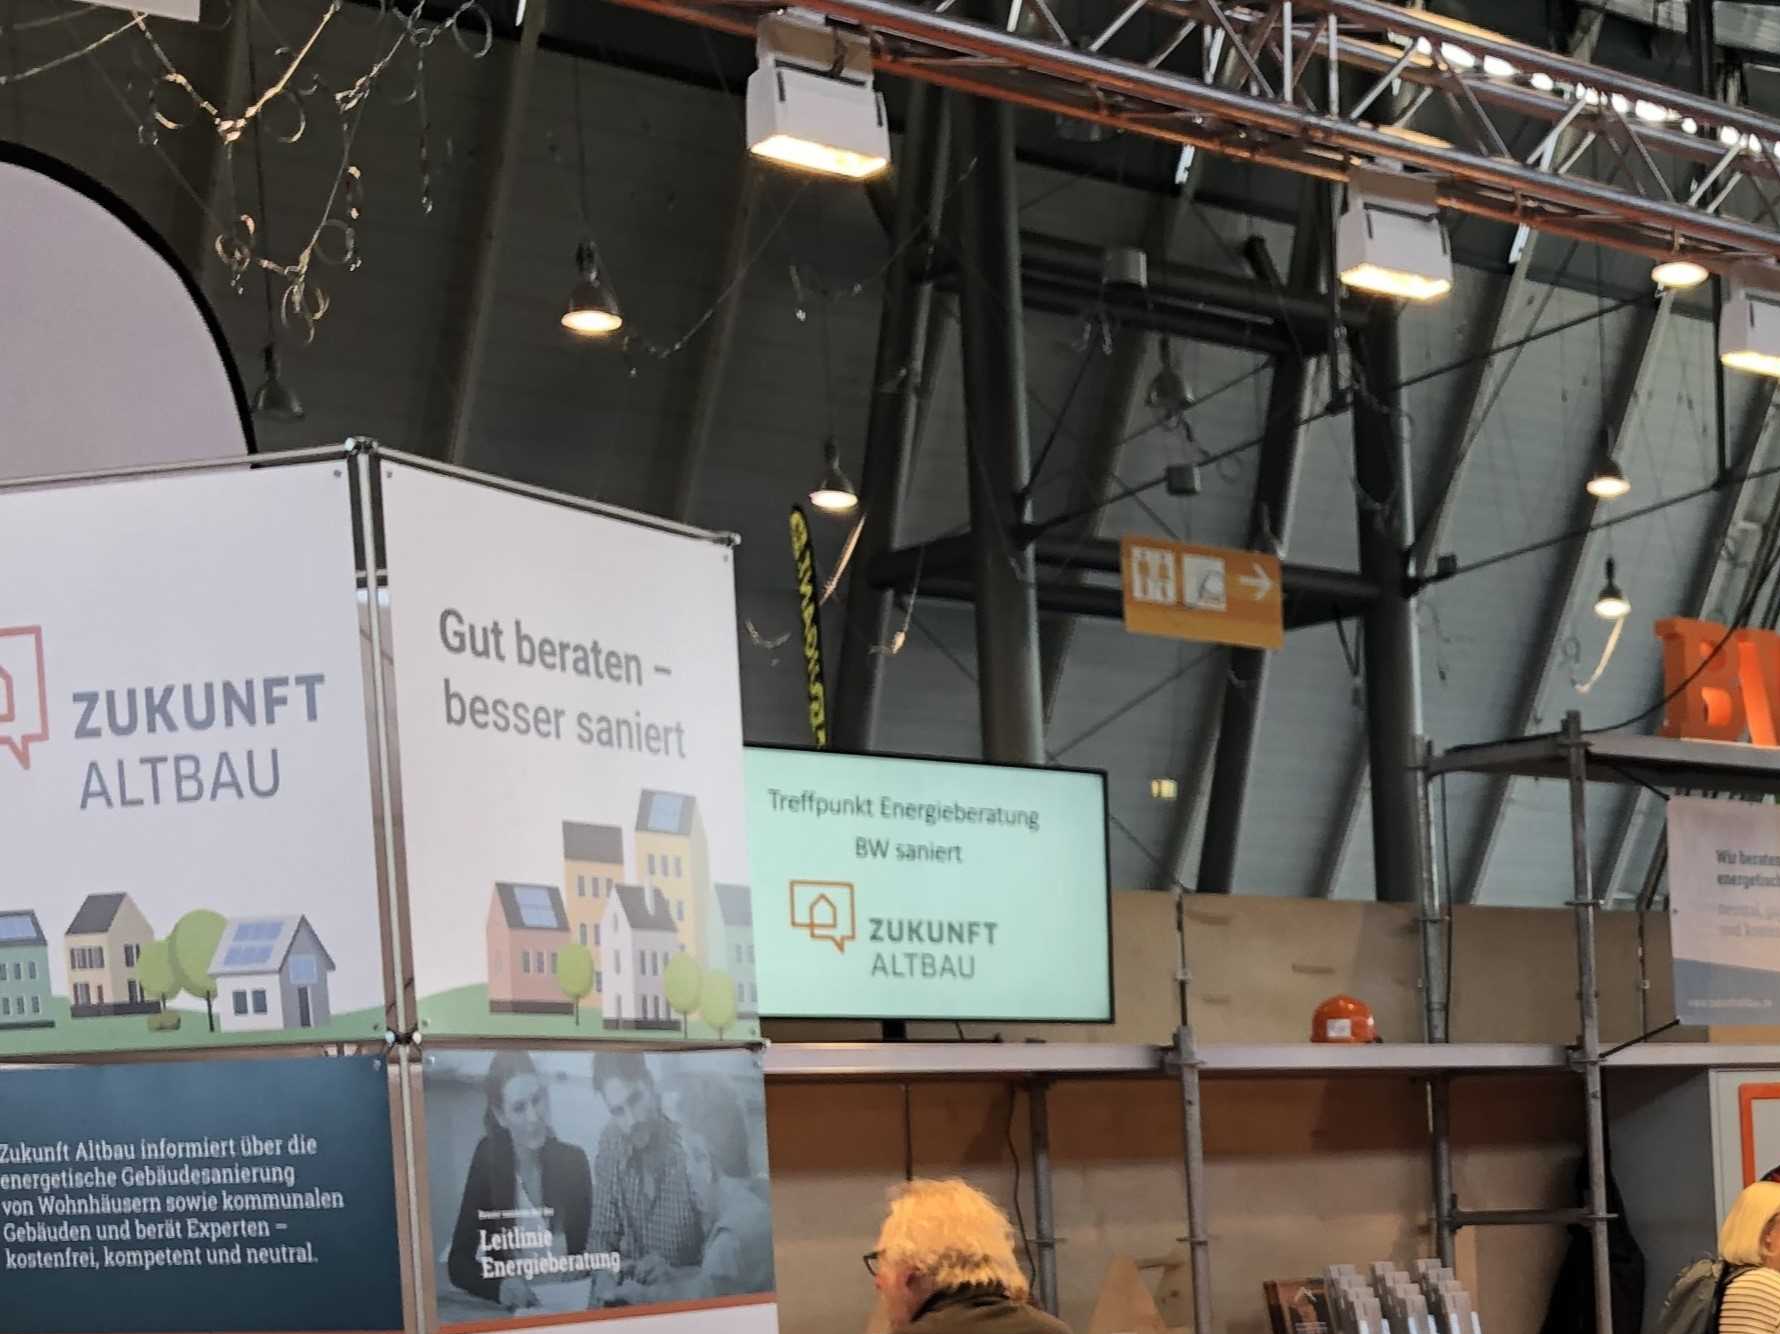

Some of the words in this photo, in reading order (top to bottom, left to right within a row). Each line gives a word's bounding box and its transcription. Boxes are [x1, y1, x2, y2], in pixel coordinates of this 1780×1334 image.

[439, 608, 505, 662] Gut
[515, 621, 643, 686] beraten
[72, 673, 326, 738] ZUKUNFT
[444, 679, 566, 740] besser
[576, 706, 687, 759] saniert
[80, 748, 281, 809] ALTBAU
[768, 788, 874, 818] Treffpunkt
[880, 796, 1040, 831] Energieberatung
[856, 837, 888, 859] BW
[896, 840, 963, 863] saniert
[869, 918, 999, 946] ZUKUNFT
[871, 953, 975, 979] ALTBAU
[0, 1142, 69, 1164] Zukunft
[76, 1140, 135, 1161] Altbau
[140, 1137, 235, 1160] informiert
[241, 1136, 283, 1157] über
[287, 1134, 317, 1156] die
[0, 1167, 117, 1191] energetische
[122, 1163, 296, 1188] Gebäudesanierung
[2, 1200, 34, 1216] von
[38, 1194, 161, 1215] Wohnhäusern
[166, 1193, 217, 1213] sowie
[222, 1187, 345, 1211] kommunalen
[3, 1220, 91, 1243] Gebäuden
[96, 1219, 130, 1240] und
[136, 1218, 182, 1240] berät
[186, 1217, 270, 1242] Experten
[479, 1226, 553, 1252] Leitlinie
[6, 1248, 100, 1270] kostenfrei,
[104, 1245, 201, 1270] kompetent
[207, 1243, 242, 1265] und
[247, 1241, 319, 1264] neutral.
[480, 1250, 621, 1281] Energieberatung
